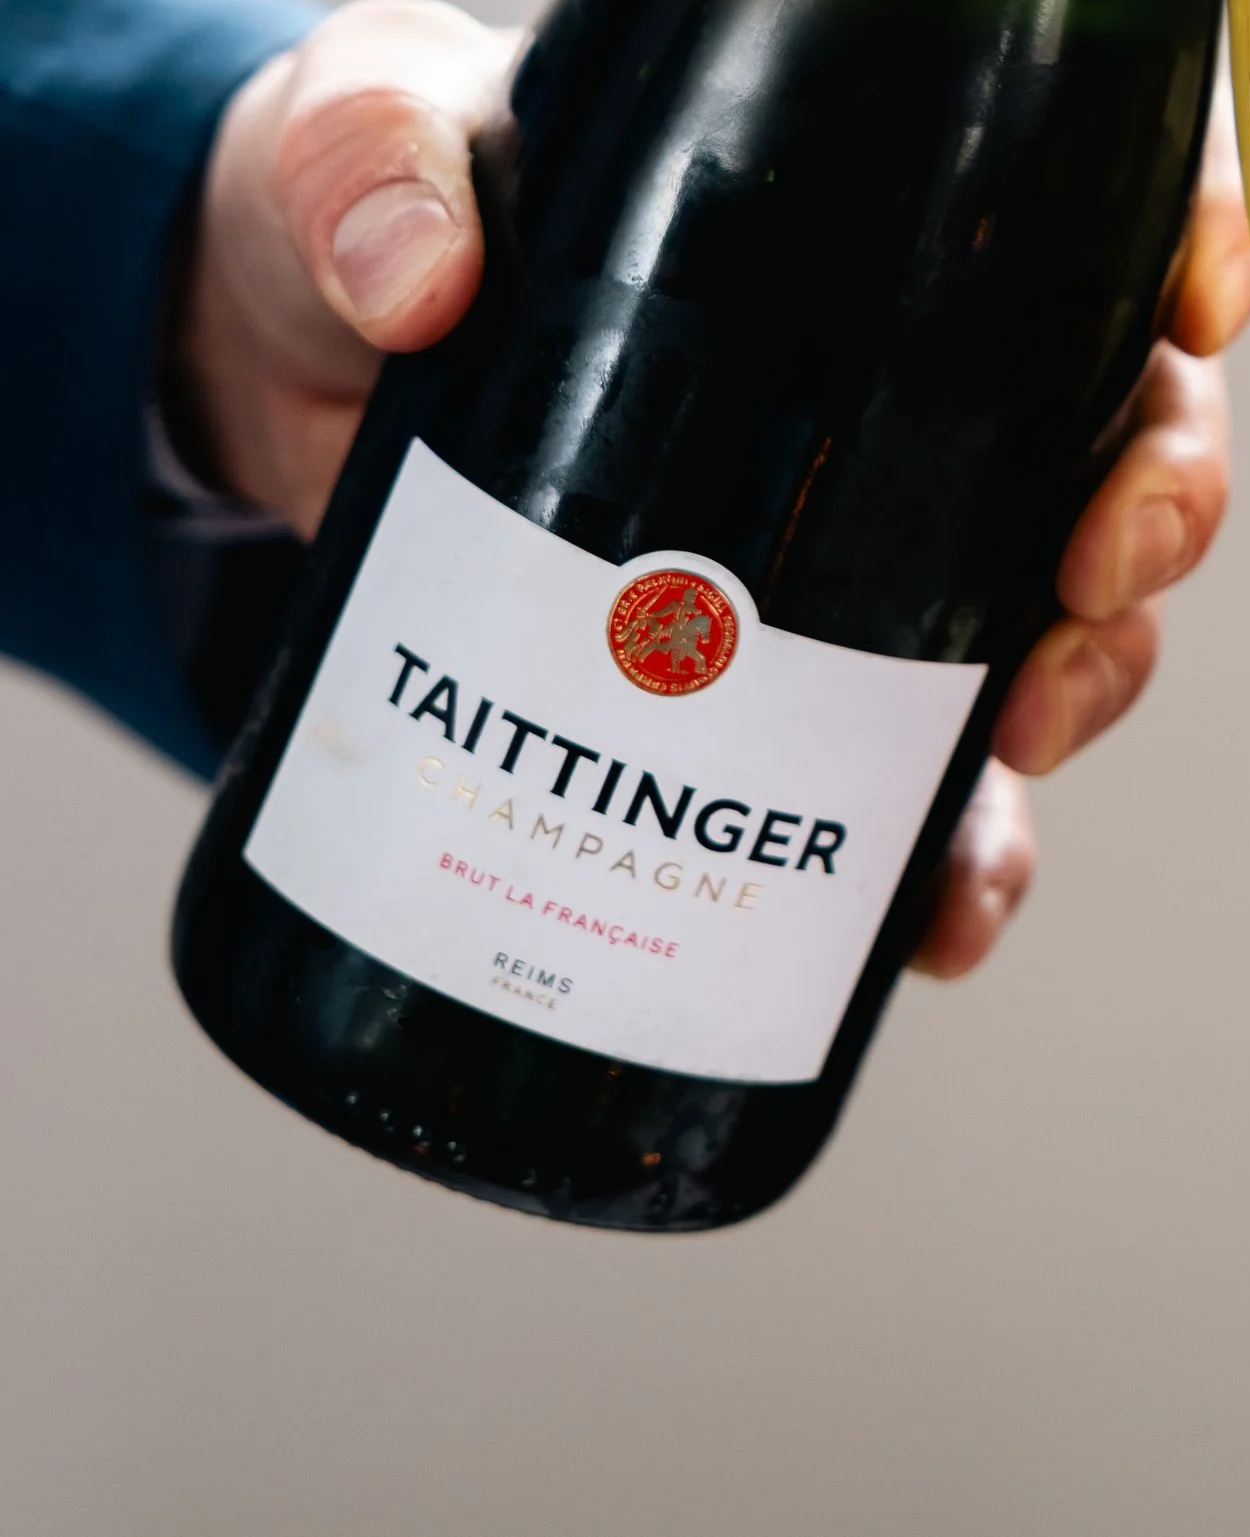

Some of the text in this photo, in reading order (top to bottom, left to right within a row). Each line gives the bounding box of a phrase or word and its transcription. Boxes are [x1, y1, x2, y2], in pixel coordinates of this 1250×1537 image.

[387, 642, 848, 875] TAITTINGER
[417, 755, 765, 911] CHAMPAGNE
[439, 851, 680, 959] BRUT LA FRANÇAISE
[490, 975, 558, 1010] FRANCE
[493, 950, 574, 995] REIMS
